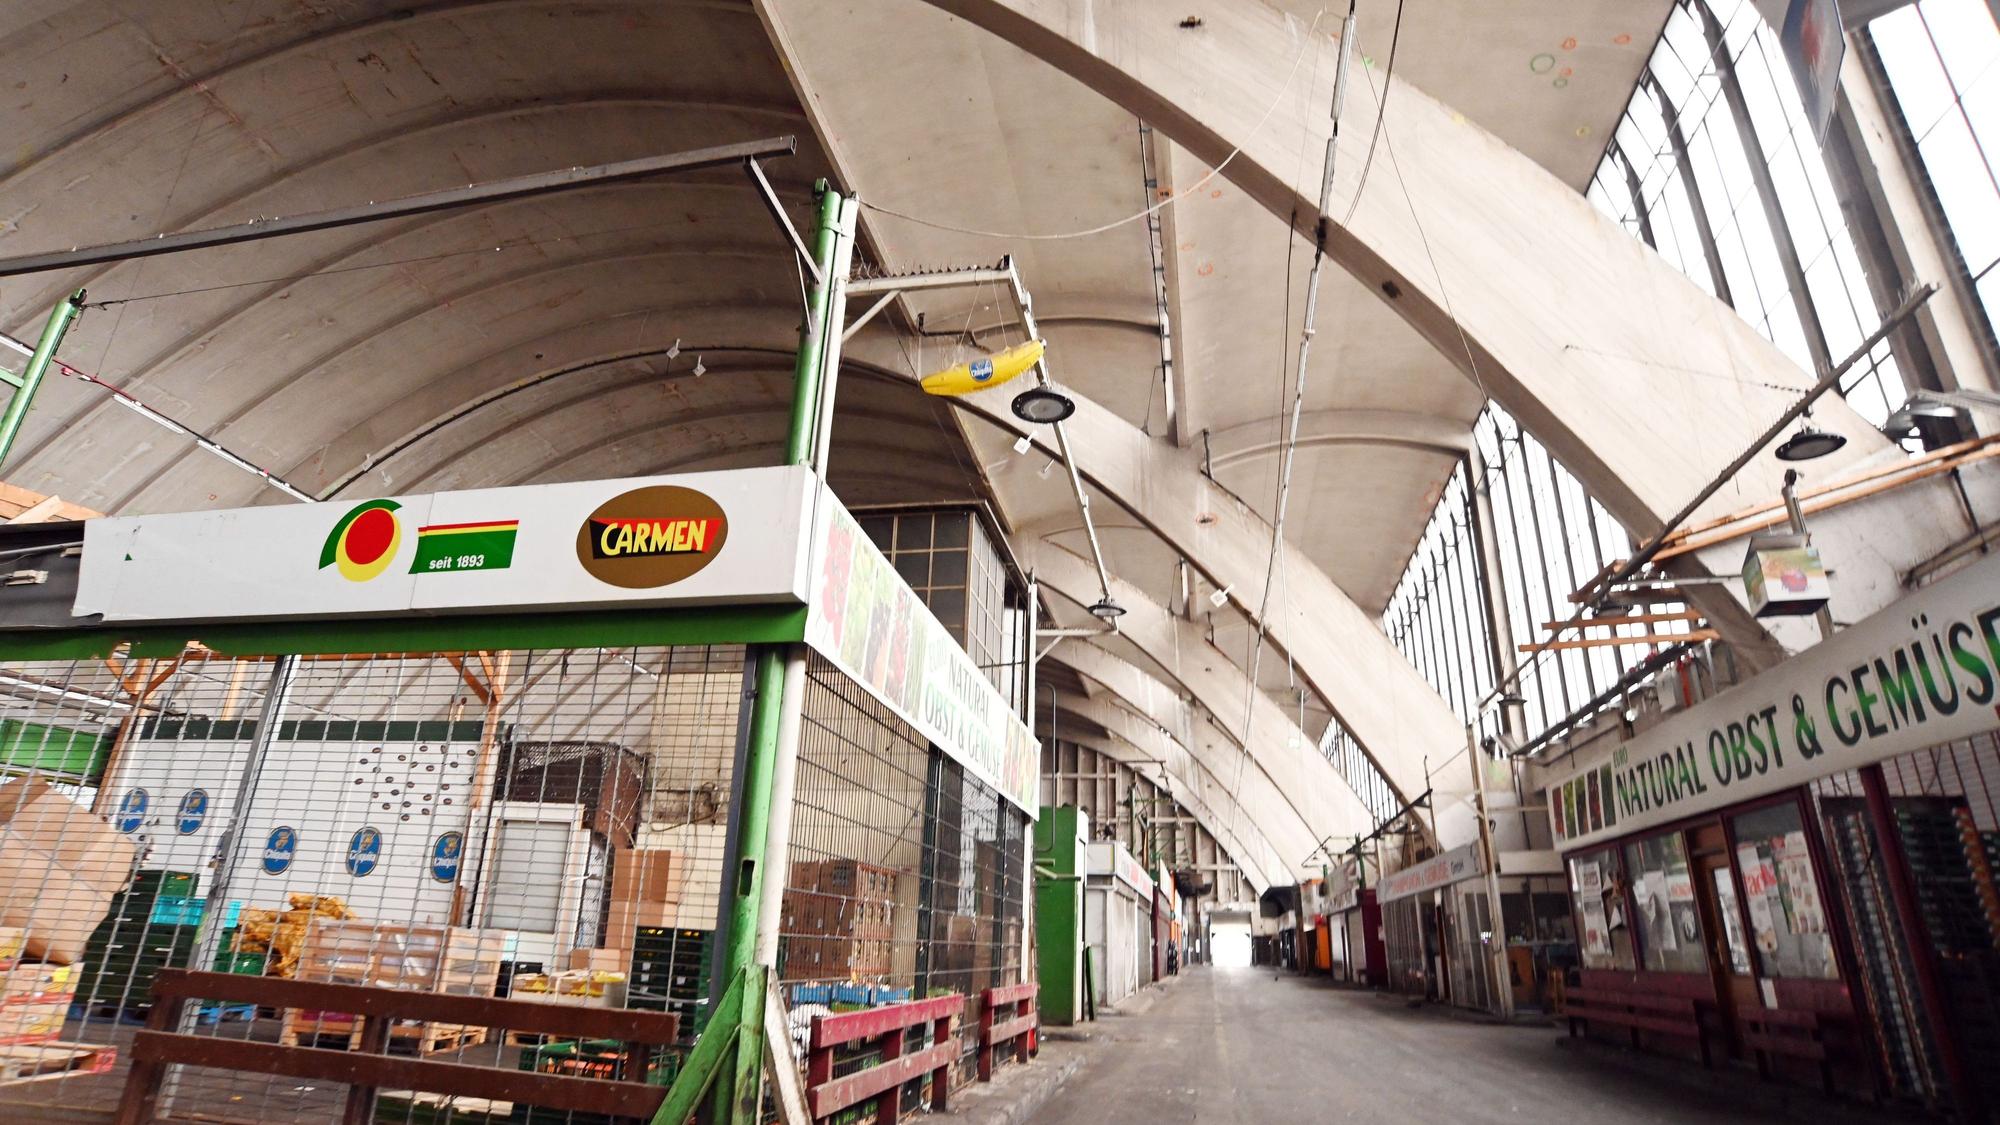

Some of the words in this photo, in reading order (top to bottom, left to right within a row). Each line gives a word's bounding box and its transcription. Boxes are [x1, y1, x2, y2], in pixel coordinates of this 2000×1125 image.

[429, 556, 452, 569] seit
[456, 554, 485, 568] 1893
[600, 519, 707, 556] CARMEN
[925, 680, 956, 742] OBST
[949, 652, 990, 728] NATURAL
[1615, 741, 1707, 819] NATURAL
[1708, 704, 1783, 787] OBST
[1791, 694, 1824, 760] &
